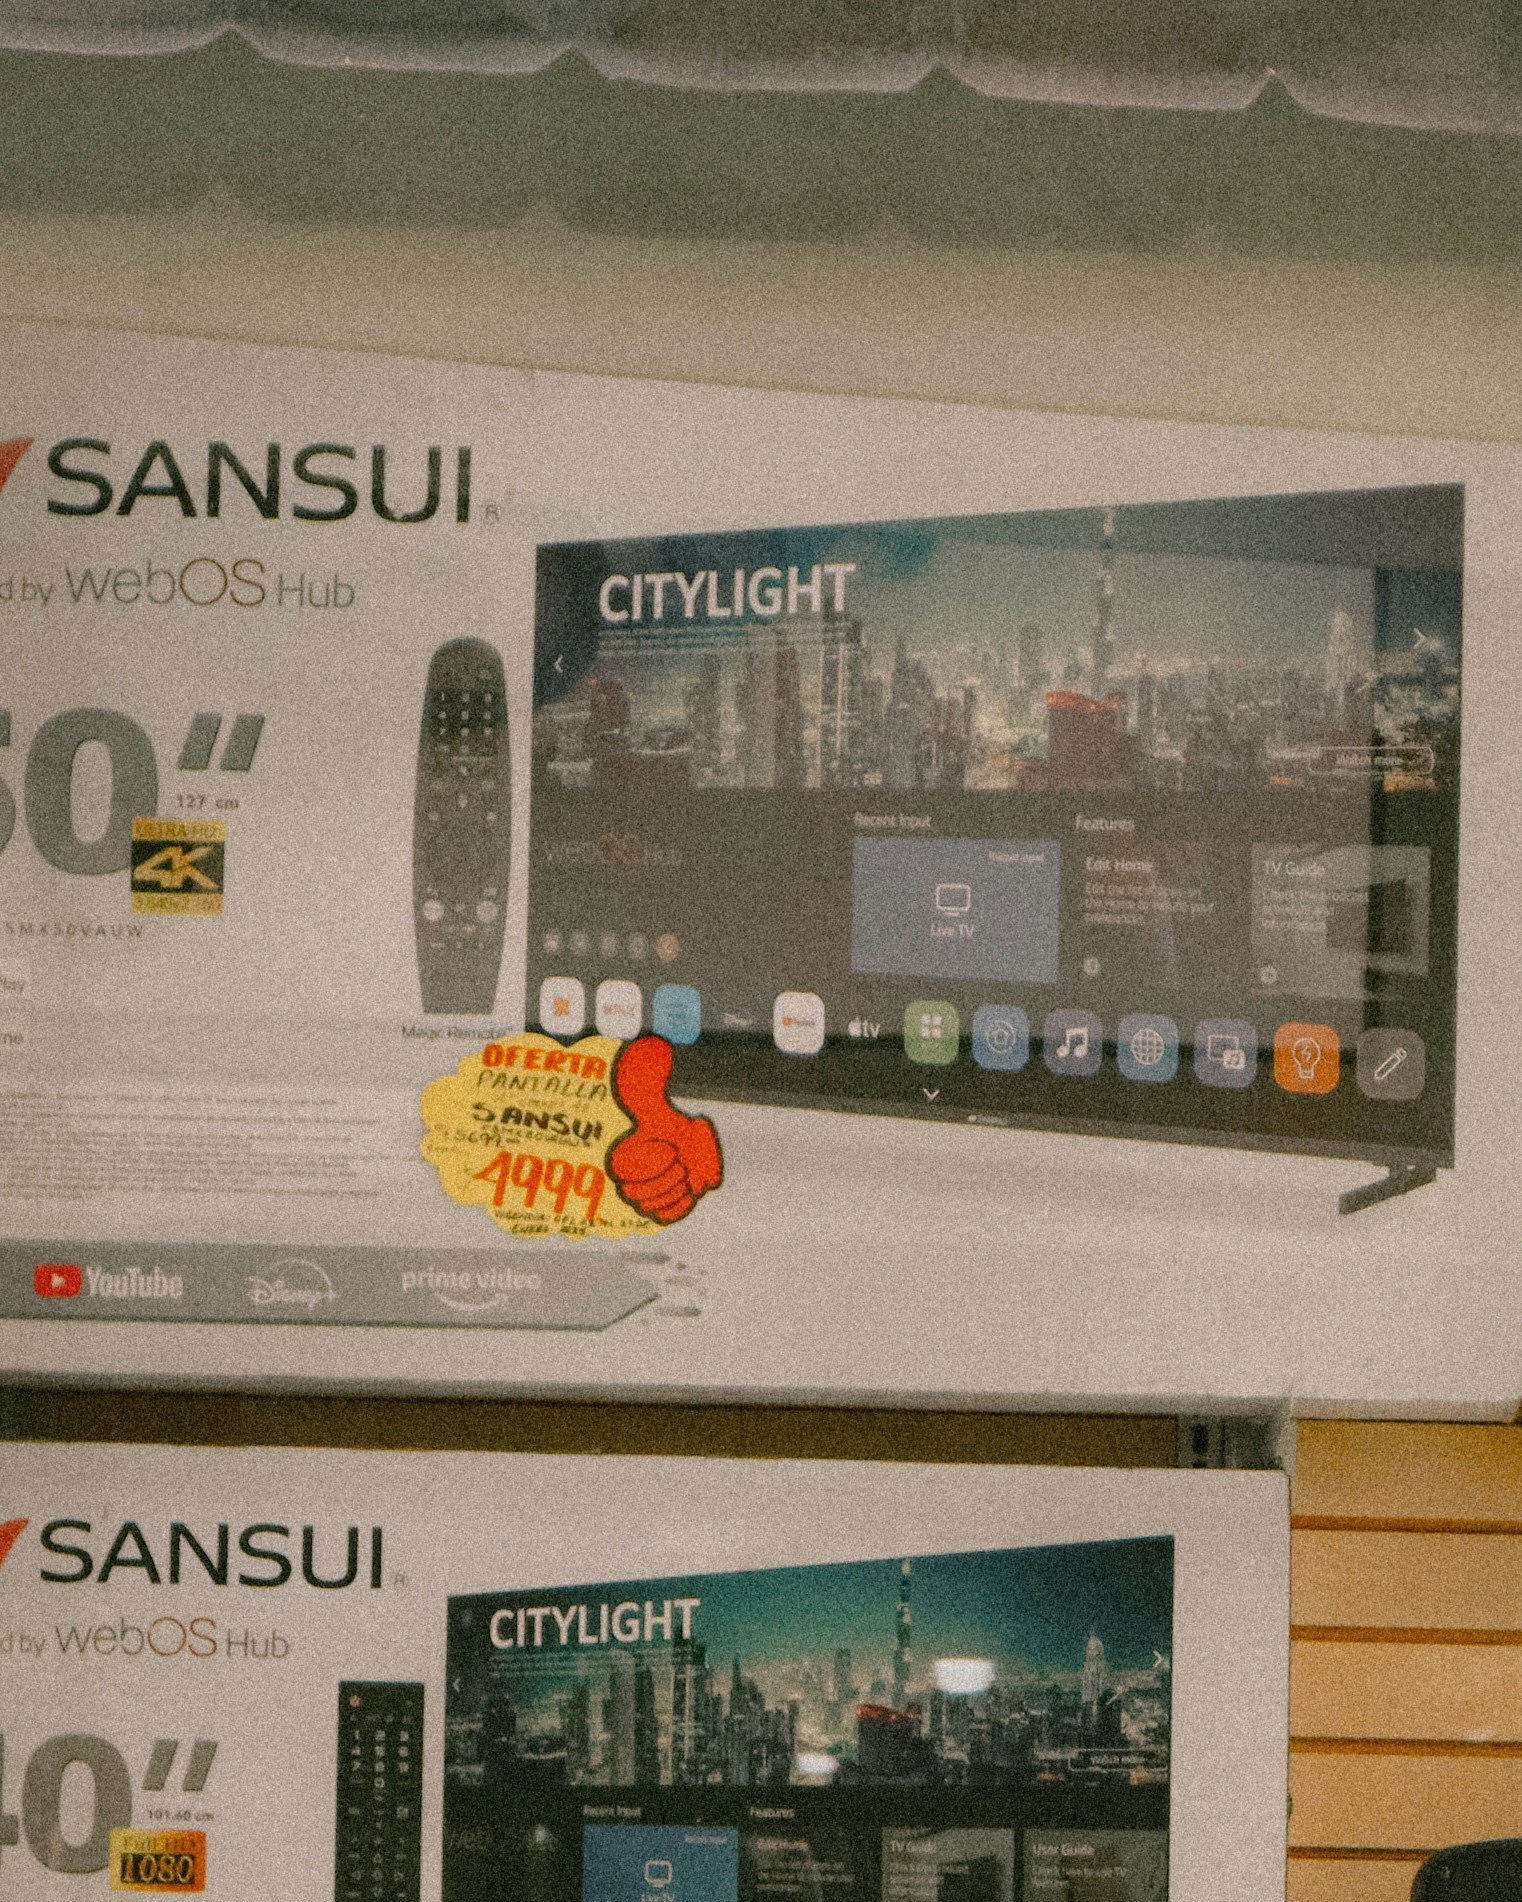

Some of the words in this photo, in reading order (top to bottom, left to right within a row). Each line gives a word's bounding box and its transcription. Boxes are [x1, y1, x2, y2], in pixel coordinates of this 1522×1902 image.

[46, 437, 473, 524] SANSUI
[276, 572, 356, 610] Hub
[600, 563, 857, 622] CITYLIGHT
[133, 845, 222, 890] 4K
[482, 1043, 608, 1079] OFERTA
[476, 1069, 608, 1101] PANTALLA
[471, 1102, 603, 1139] SANSUI
[472, 1150, 606, 1225] 4999
[85, 1263, 184, 1300] YouTube
[40, 1518, 384, 1590] SANSUI
[489, 1597, 702, 1650] CITYLIGHT
[225, 1627, 290, 1660] Hub
[121, 1853, 194, 1884] 1080
